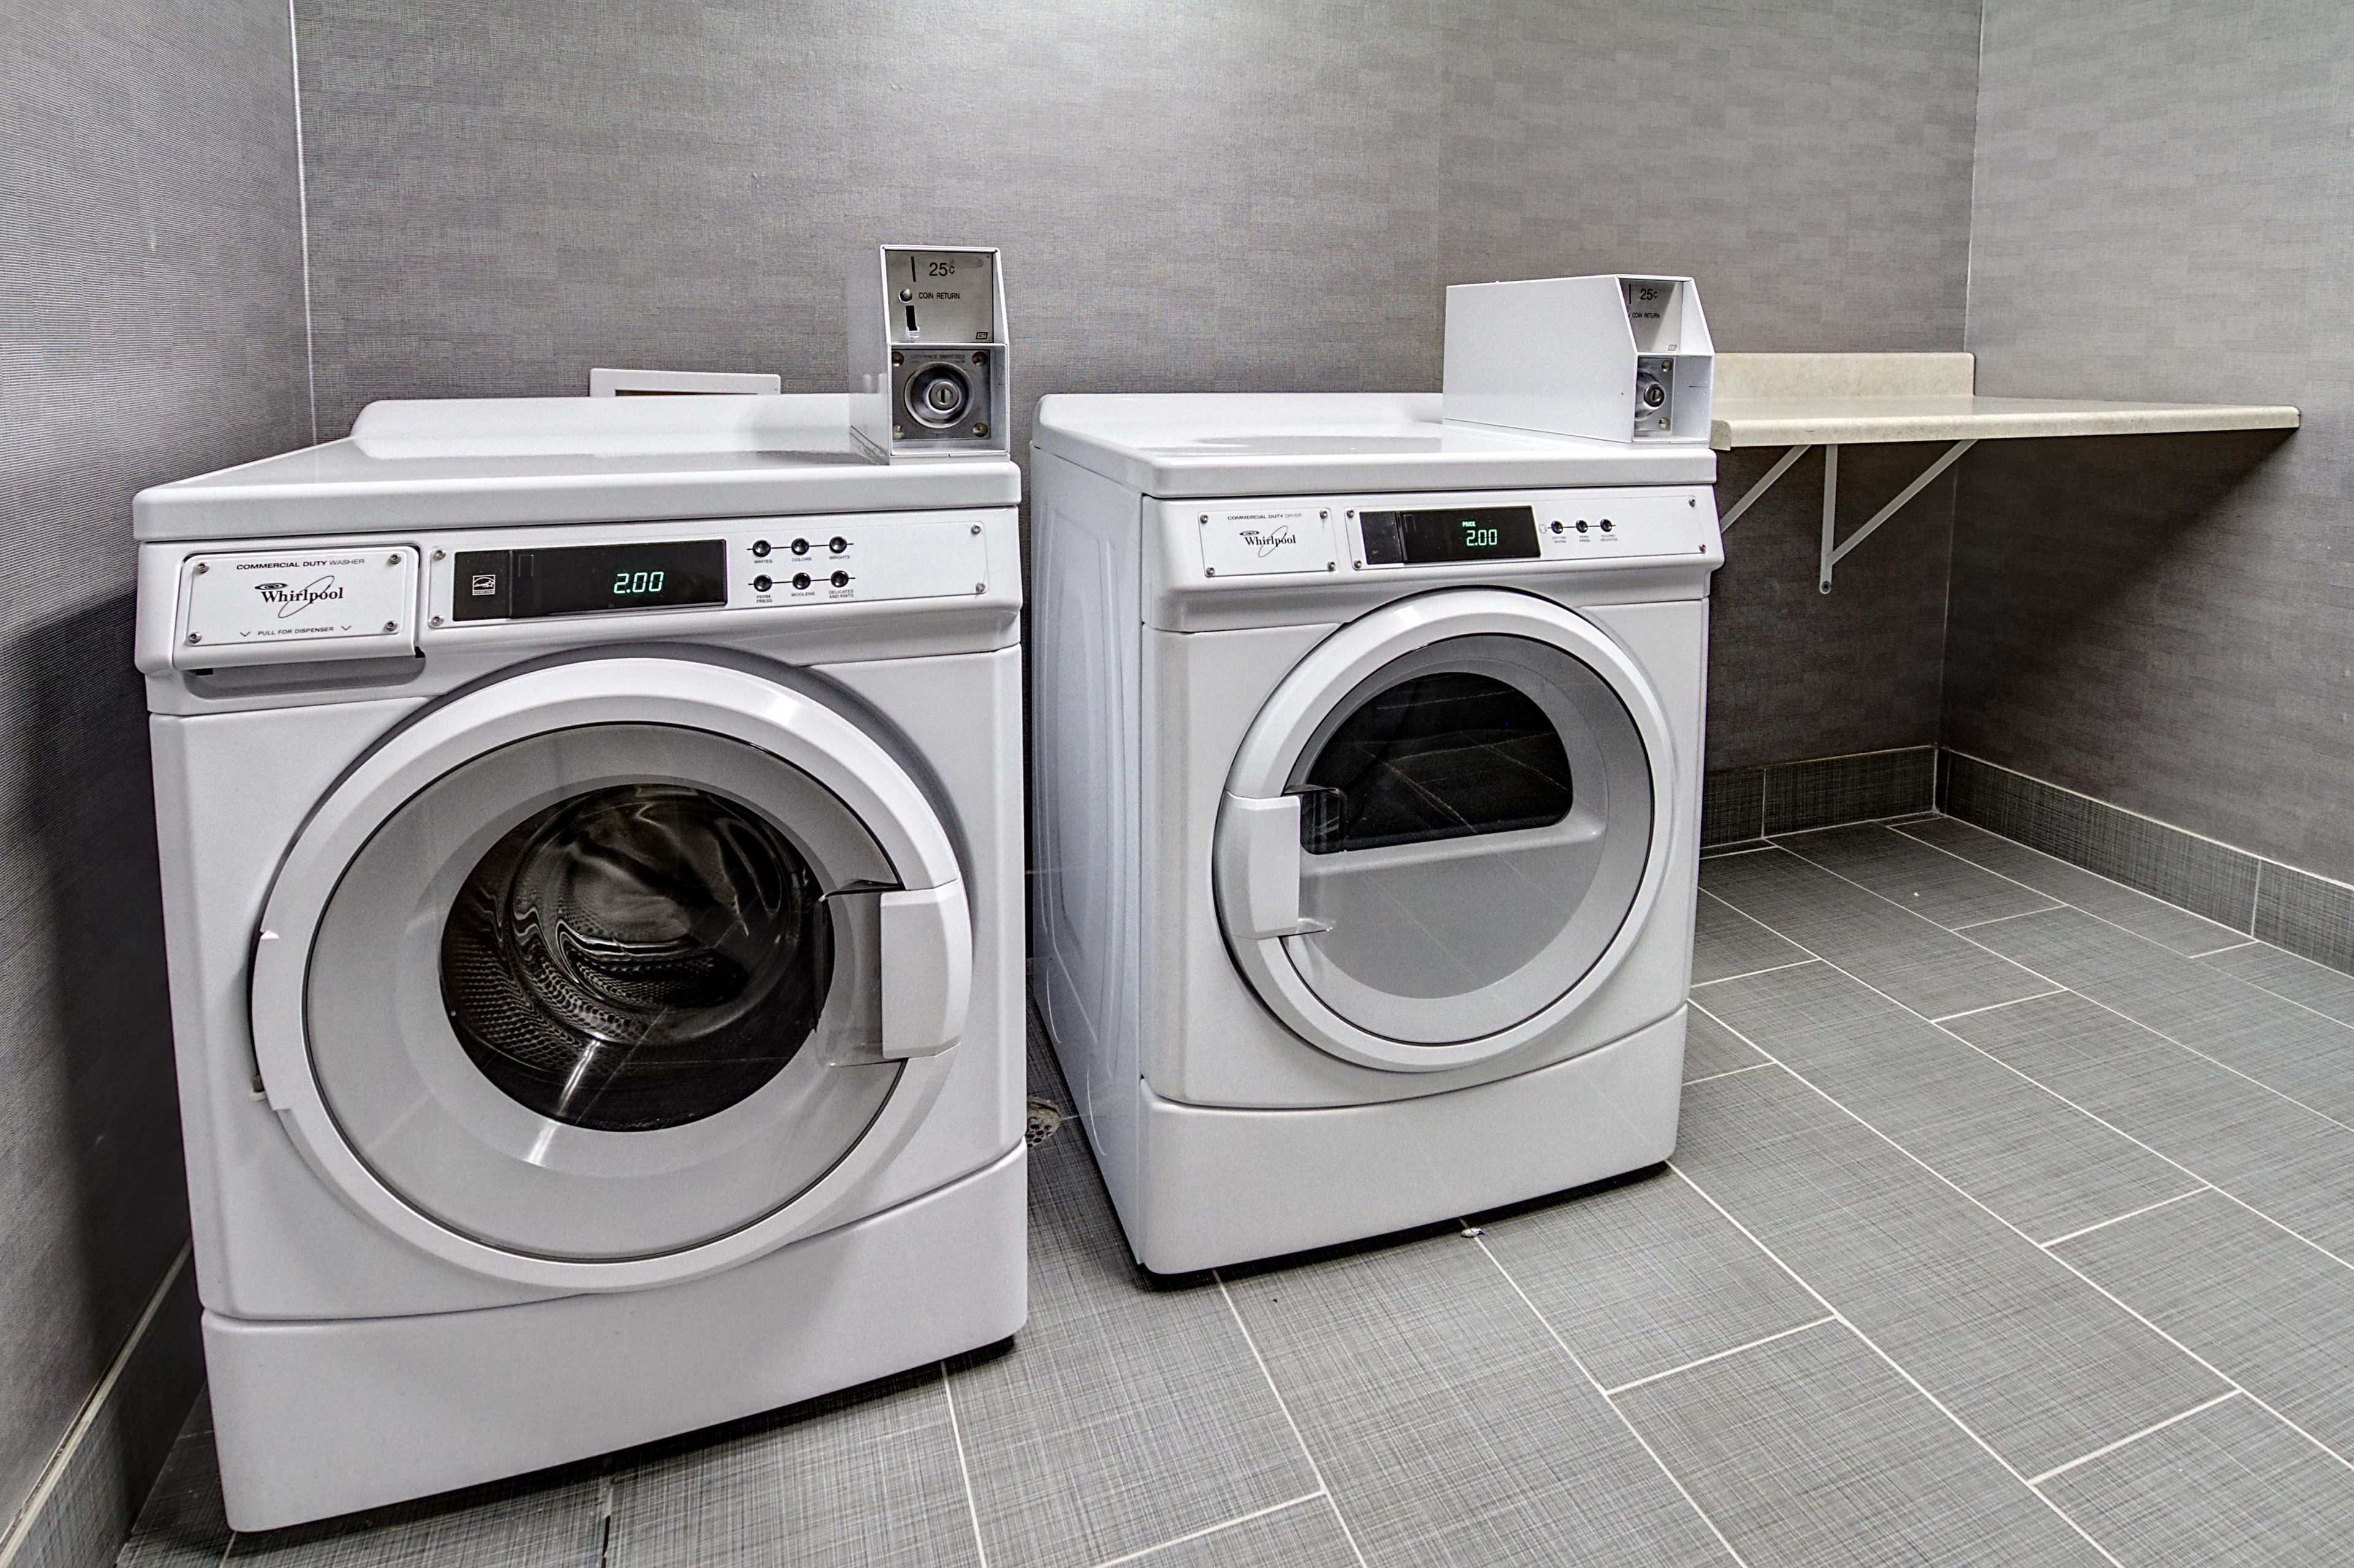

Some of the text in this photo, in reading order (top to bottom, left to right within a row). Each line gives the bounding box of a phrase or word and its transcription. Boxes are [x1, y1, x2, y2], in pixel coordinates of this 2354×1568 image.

[1244, 535, 1296, 547] Whirlpool
[1466, 529, 1497, 546] 2.00
[614, 571, 664, 593] 2.00
[261, 587, 343, 604] Whirlpool
